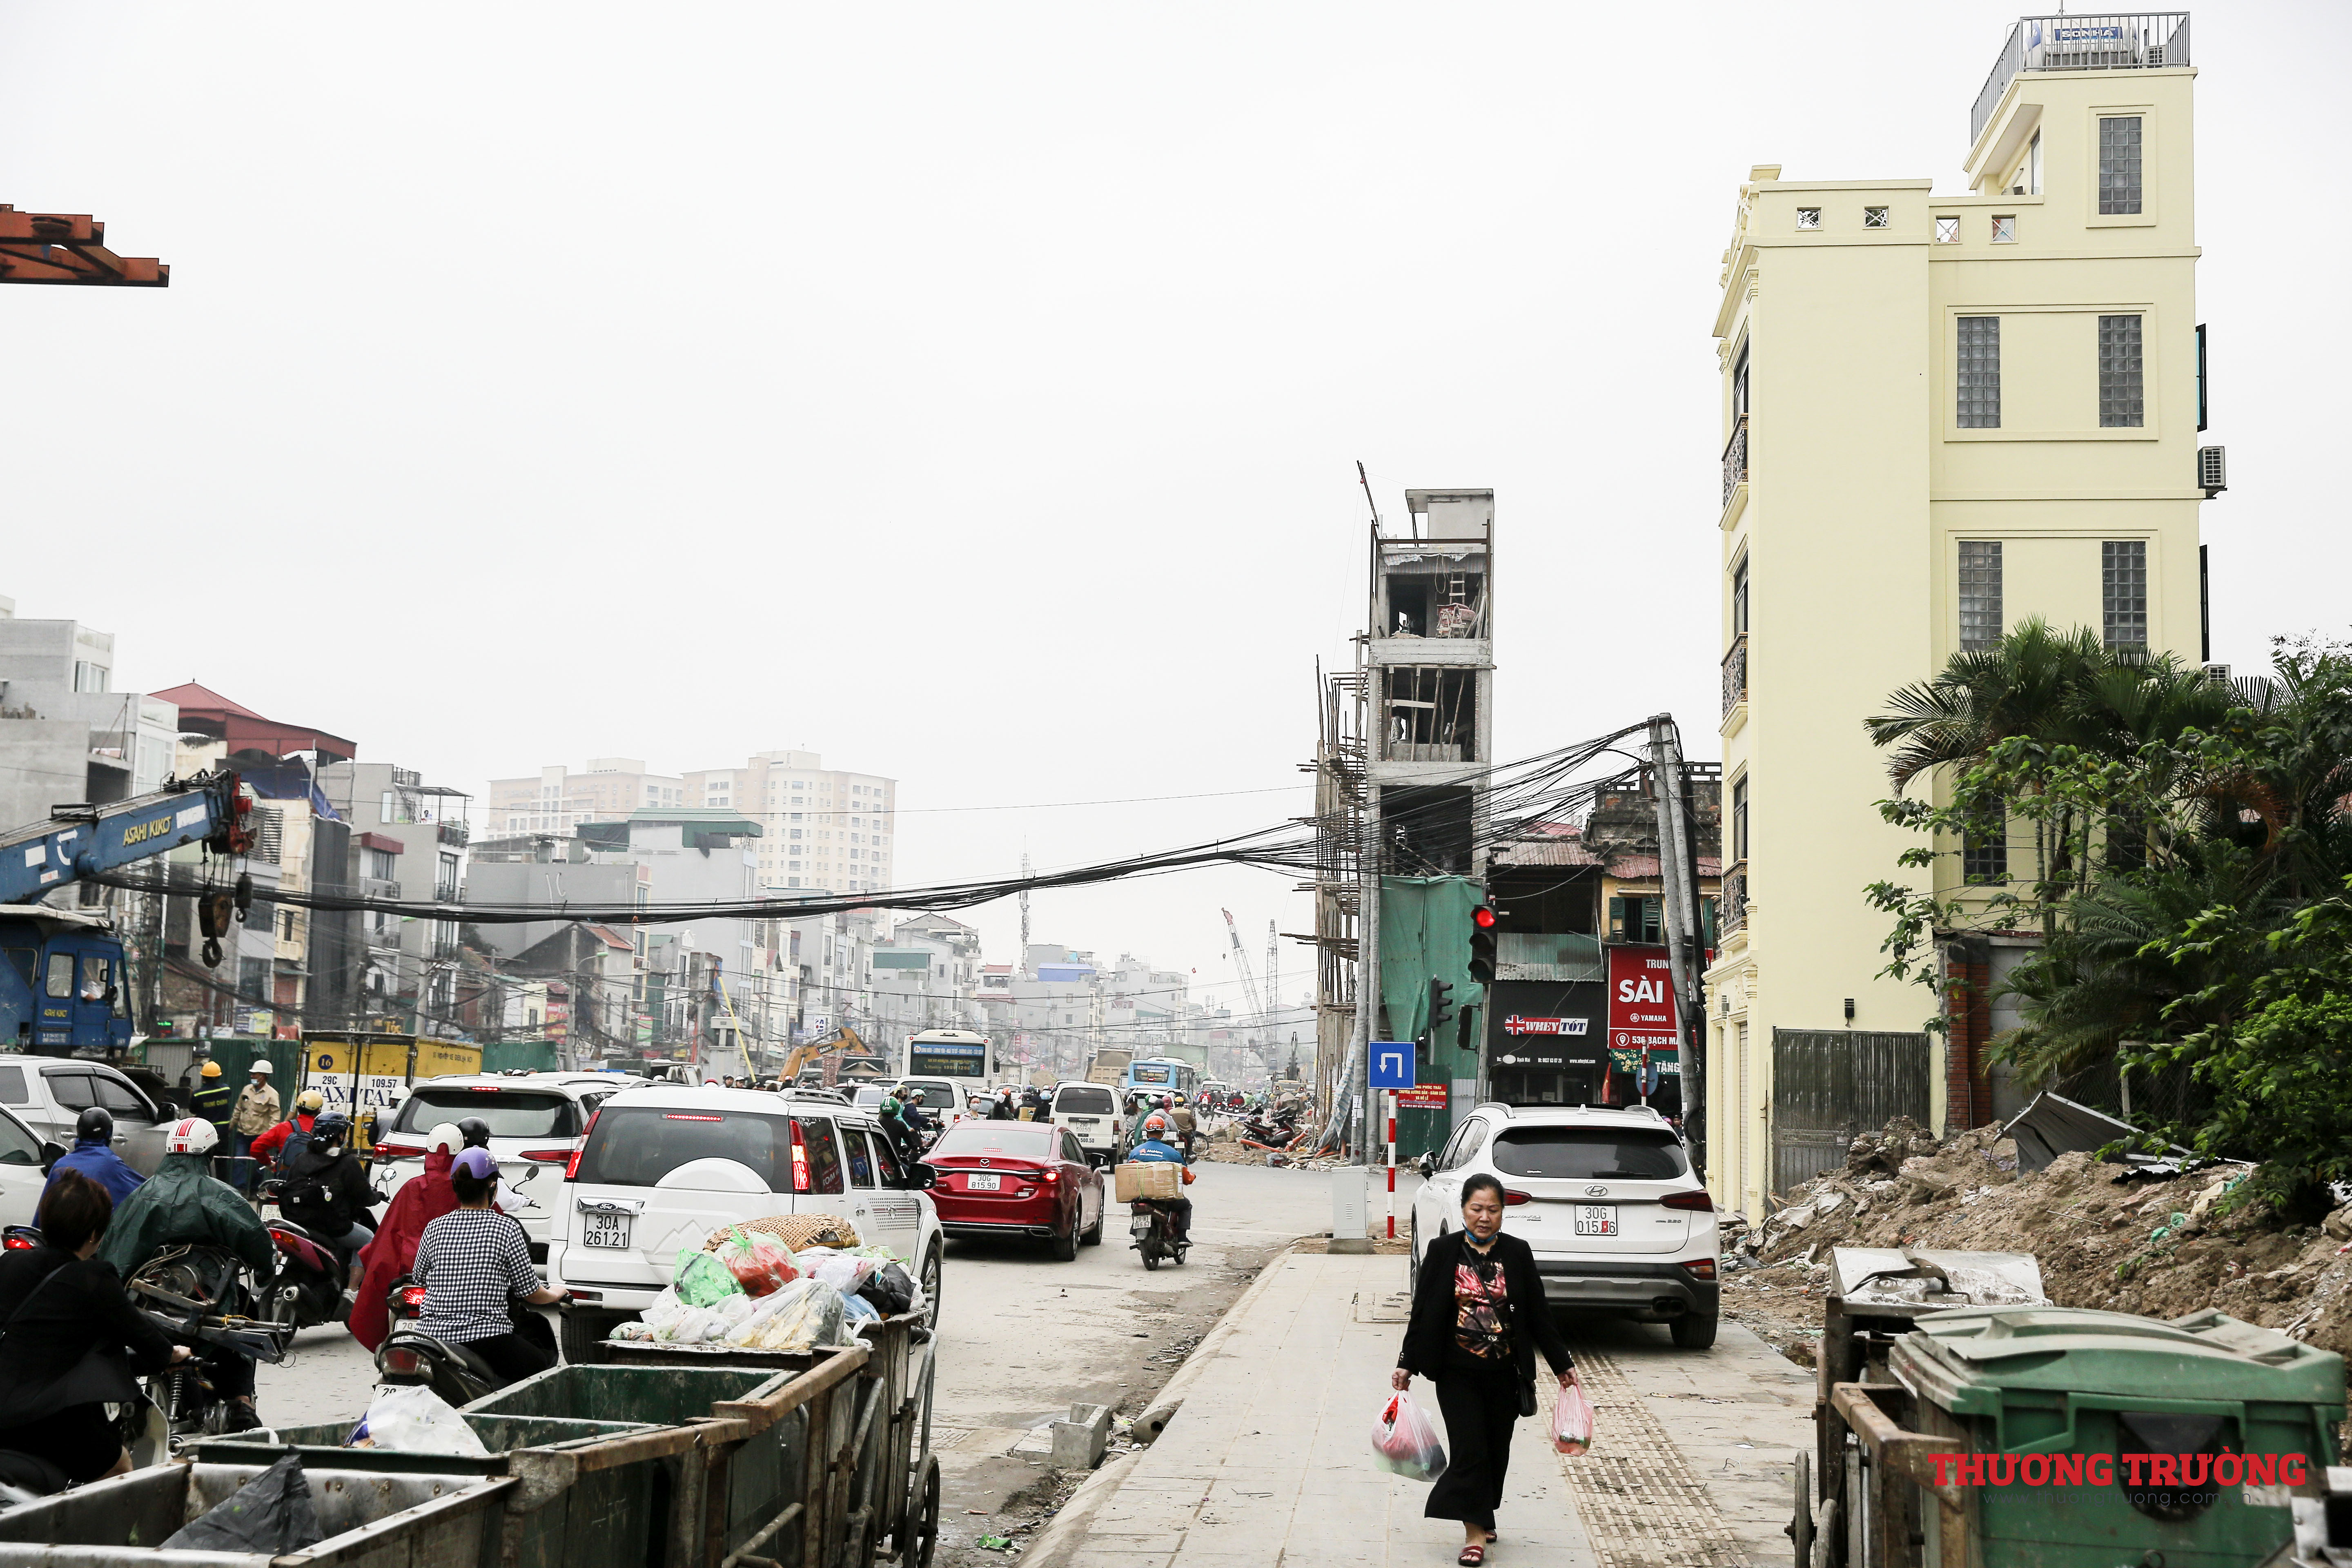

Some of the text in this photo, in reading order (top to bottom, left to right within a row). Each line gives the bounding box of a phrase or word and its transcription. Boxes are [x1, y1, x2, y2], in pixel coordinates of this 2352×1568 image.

[123, 823, 147, 847] ASAHI
[1646, 959, 1669, 969] TRUN
[1618, 975, 1664, 1003] SÀI
[1526, 1020, 1586, 1032] WHEY TỐT
[1648, 1036, 1667, 1046] BẠCH
[321, 1058, 331, 1067] 16
[1655, 1060, 1680, 1074] TẶNG
[323, 1076, 397, 1088] 29C 109.57
[1585, 1207, 1607, 1219] 30G
[596, 1215, 619, 1230] 30A
[1577, 1221, 1616, 1233] 015.6
[586, 1231, 626, 1246] 261.21
